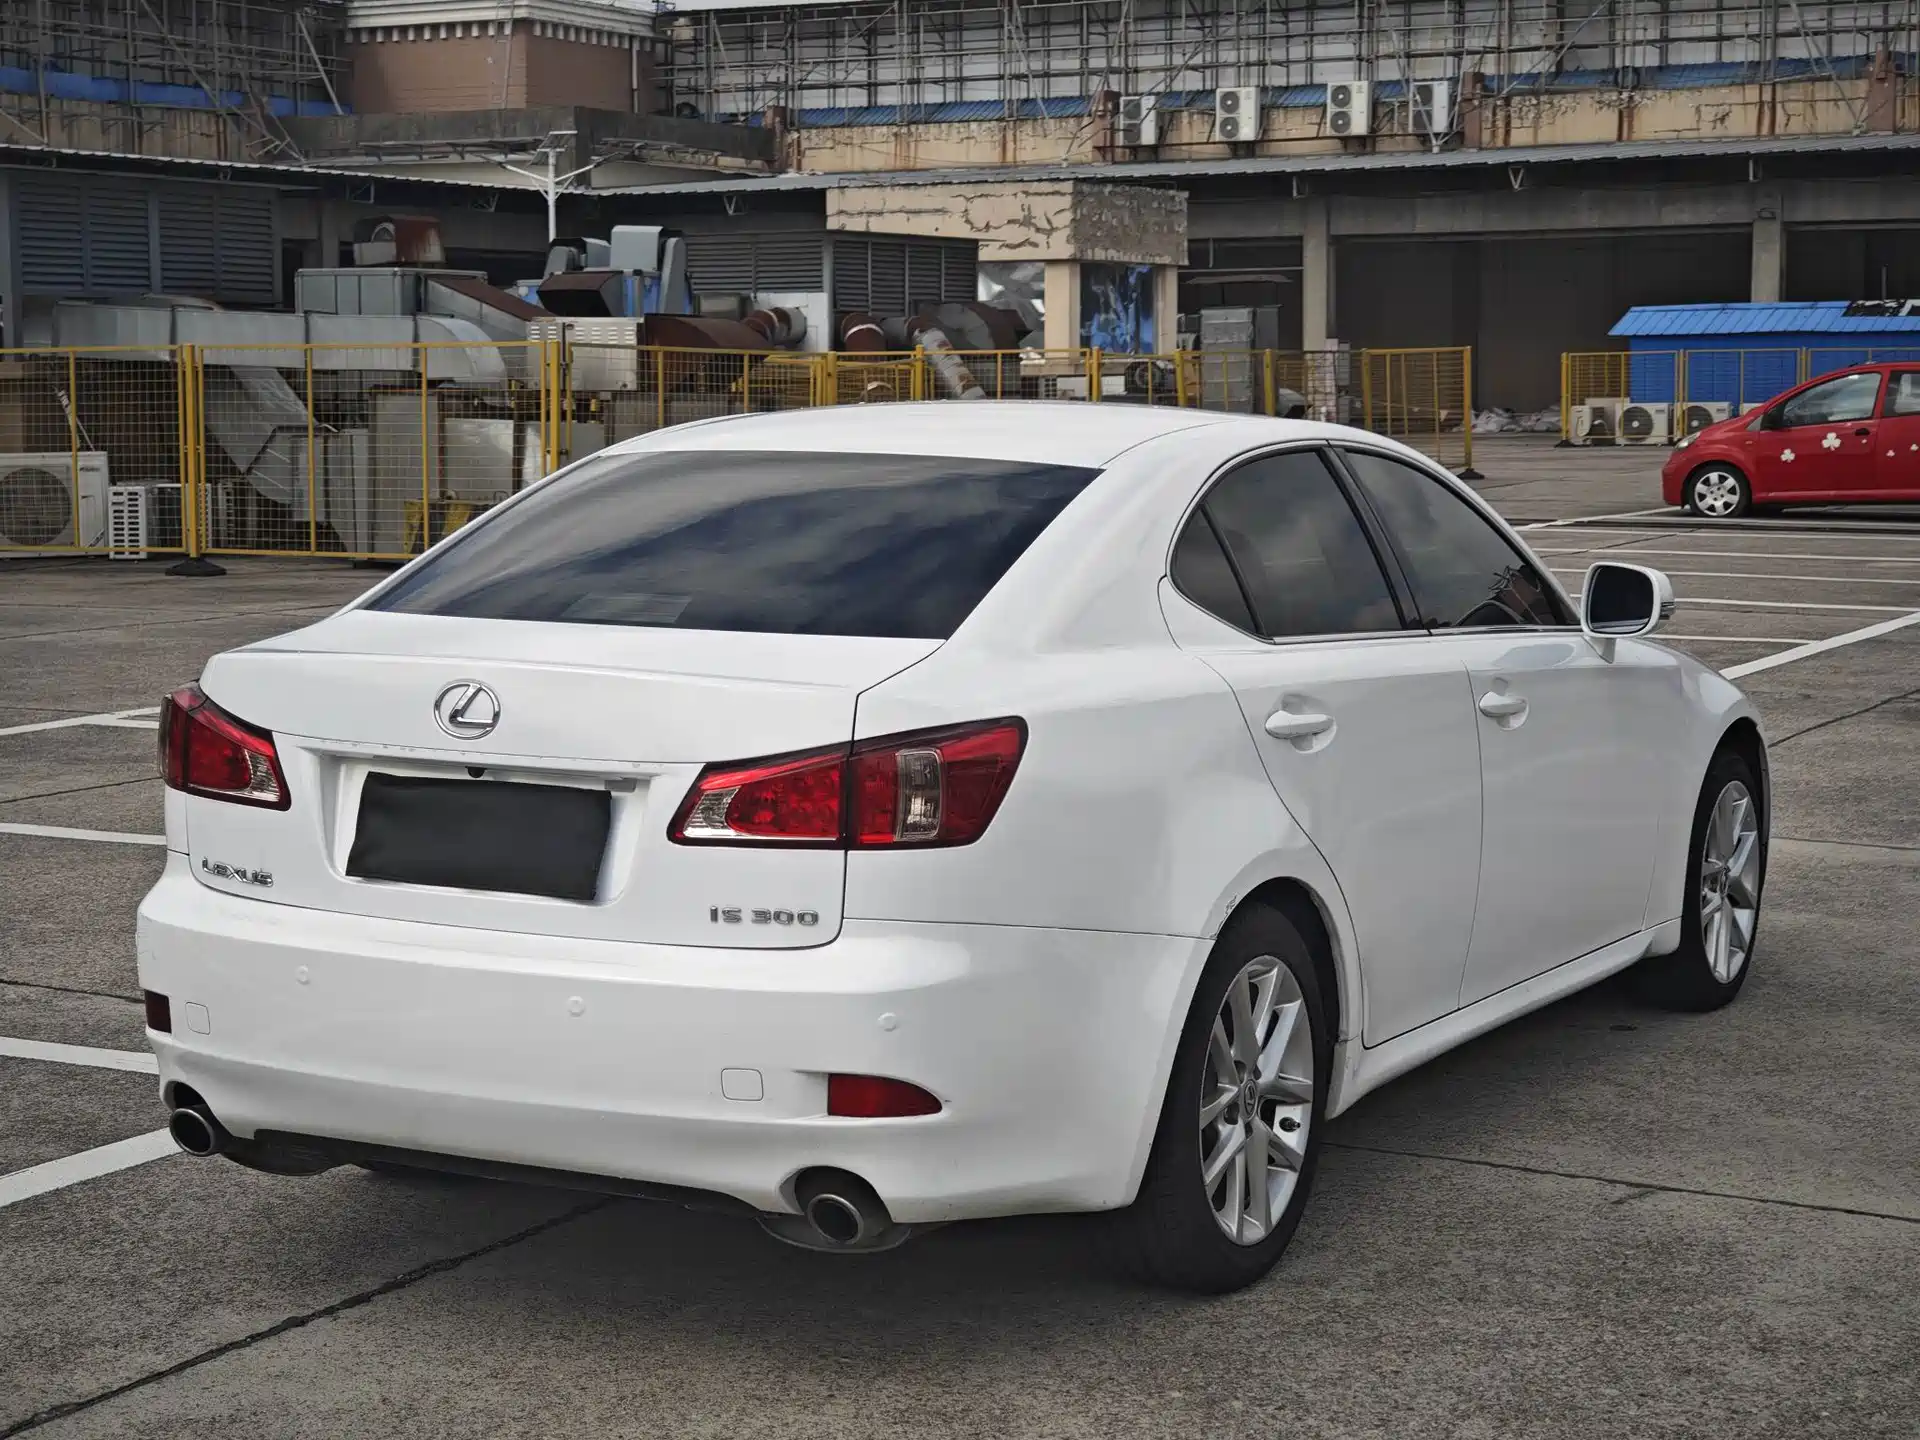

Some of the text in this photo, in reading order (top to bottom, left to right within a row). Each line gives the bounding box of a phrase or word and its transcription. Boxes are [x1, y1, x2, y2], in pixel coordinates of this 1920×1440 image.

[201, 857, 274, 888] LEXUS
[709, 905, 820, 926] IS 300
